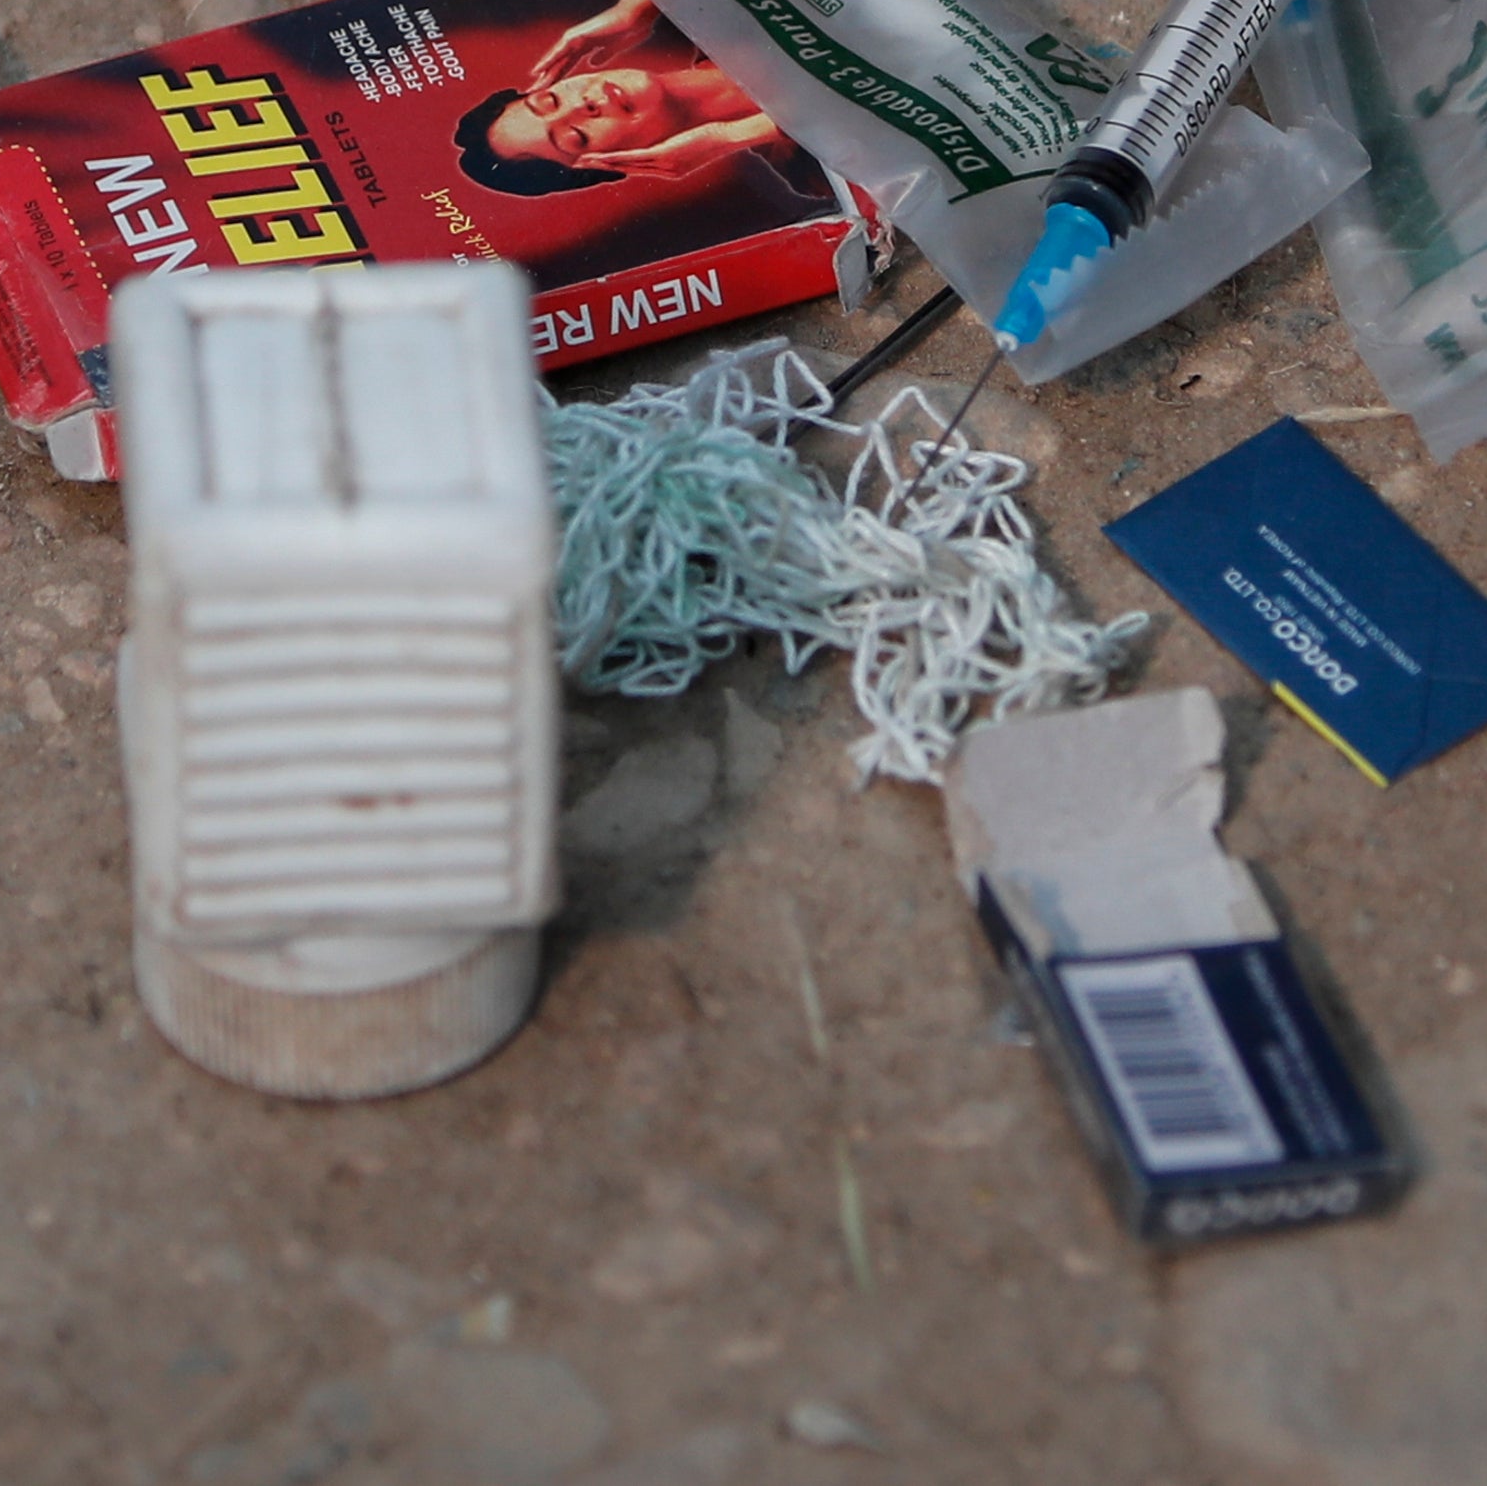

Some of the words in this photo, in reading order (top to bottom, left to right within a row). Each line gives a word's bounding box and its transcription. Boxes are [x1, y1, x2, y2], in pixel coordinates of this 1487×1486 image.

[347, 17, 381, 53] ACHE
[414, 6, 443, 38] PAIN
[766, 6, 832, 62] Part
[832, 60, 862, 83] 3
[849, 72, 990, 174] Disposable
[1173, 61, 1233, 158] DISCARD
[138, 64, 364, 267] ELIEF
[324, 109, 389, 207] TABLETS
[21, 197, 58, 248] Tablets
[84, 147, 210, 278] NEW
[419, 186, 476, 233] Relief
[45, 249, 67, 266] 10
[465, 232, 502, 263] uick
[610, 267, 722, 335] NEW
[1255, 523, 1294, 559] KOREA
[1281, 568, 1329, 610] VIETNAM
[1268, 615, 1359, 697] DORCO
